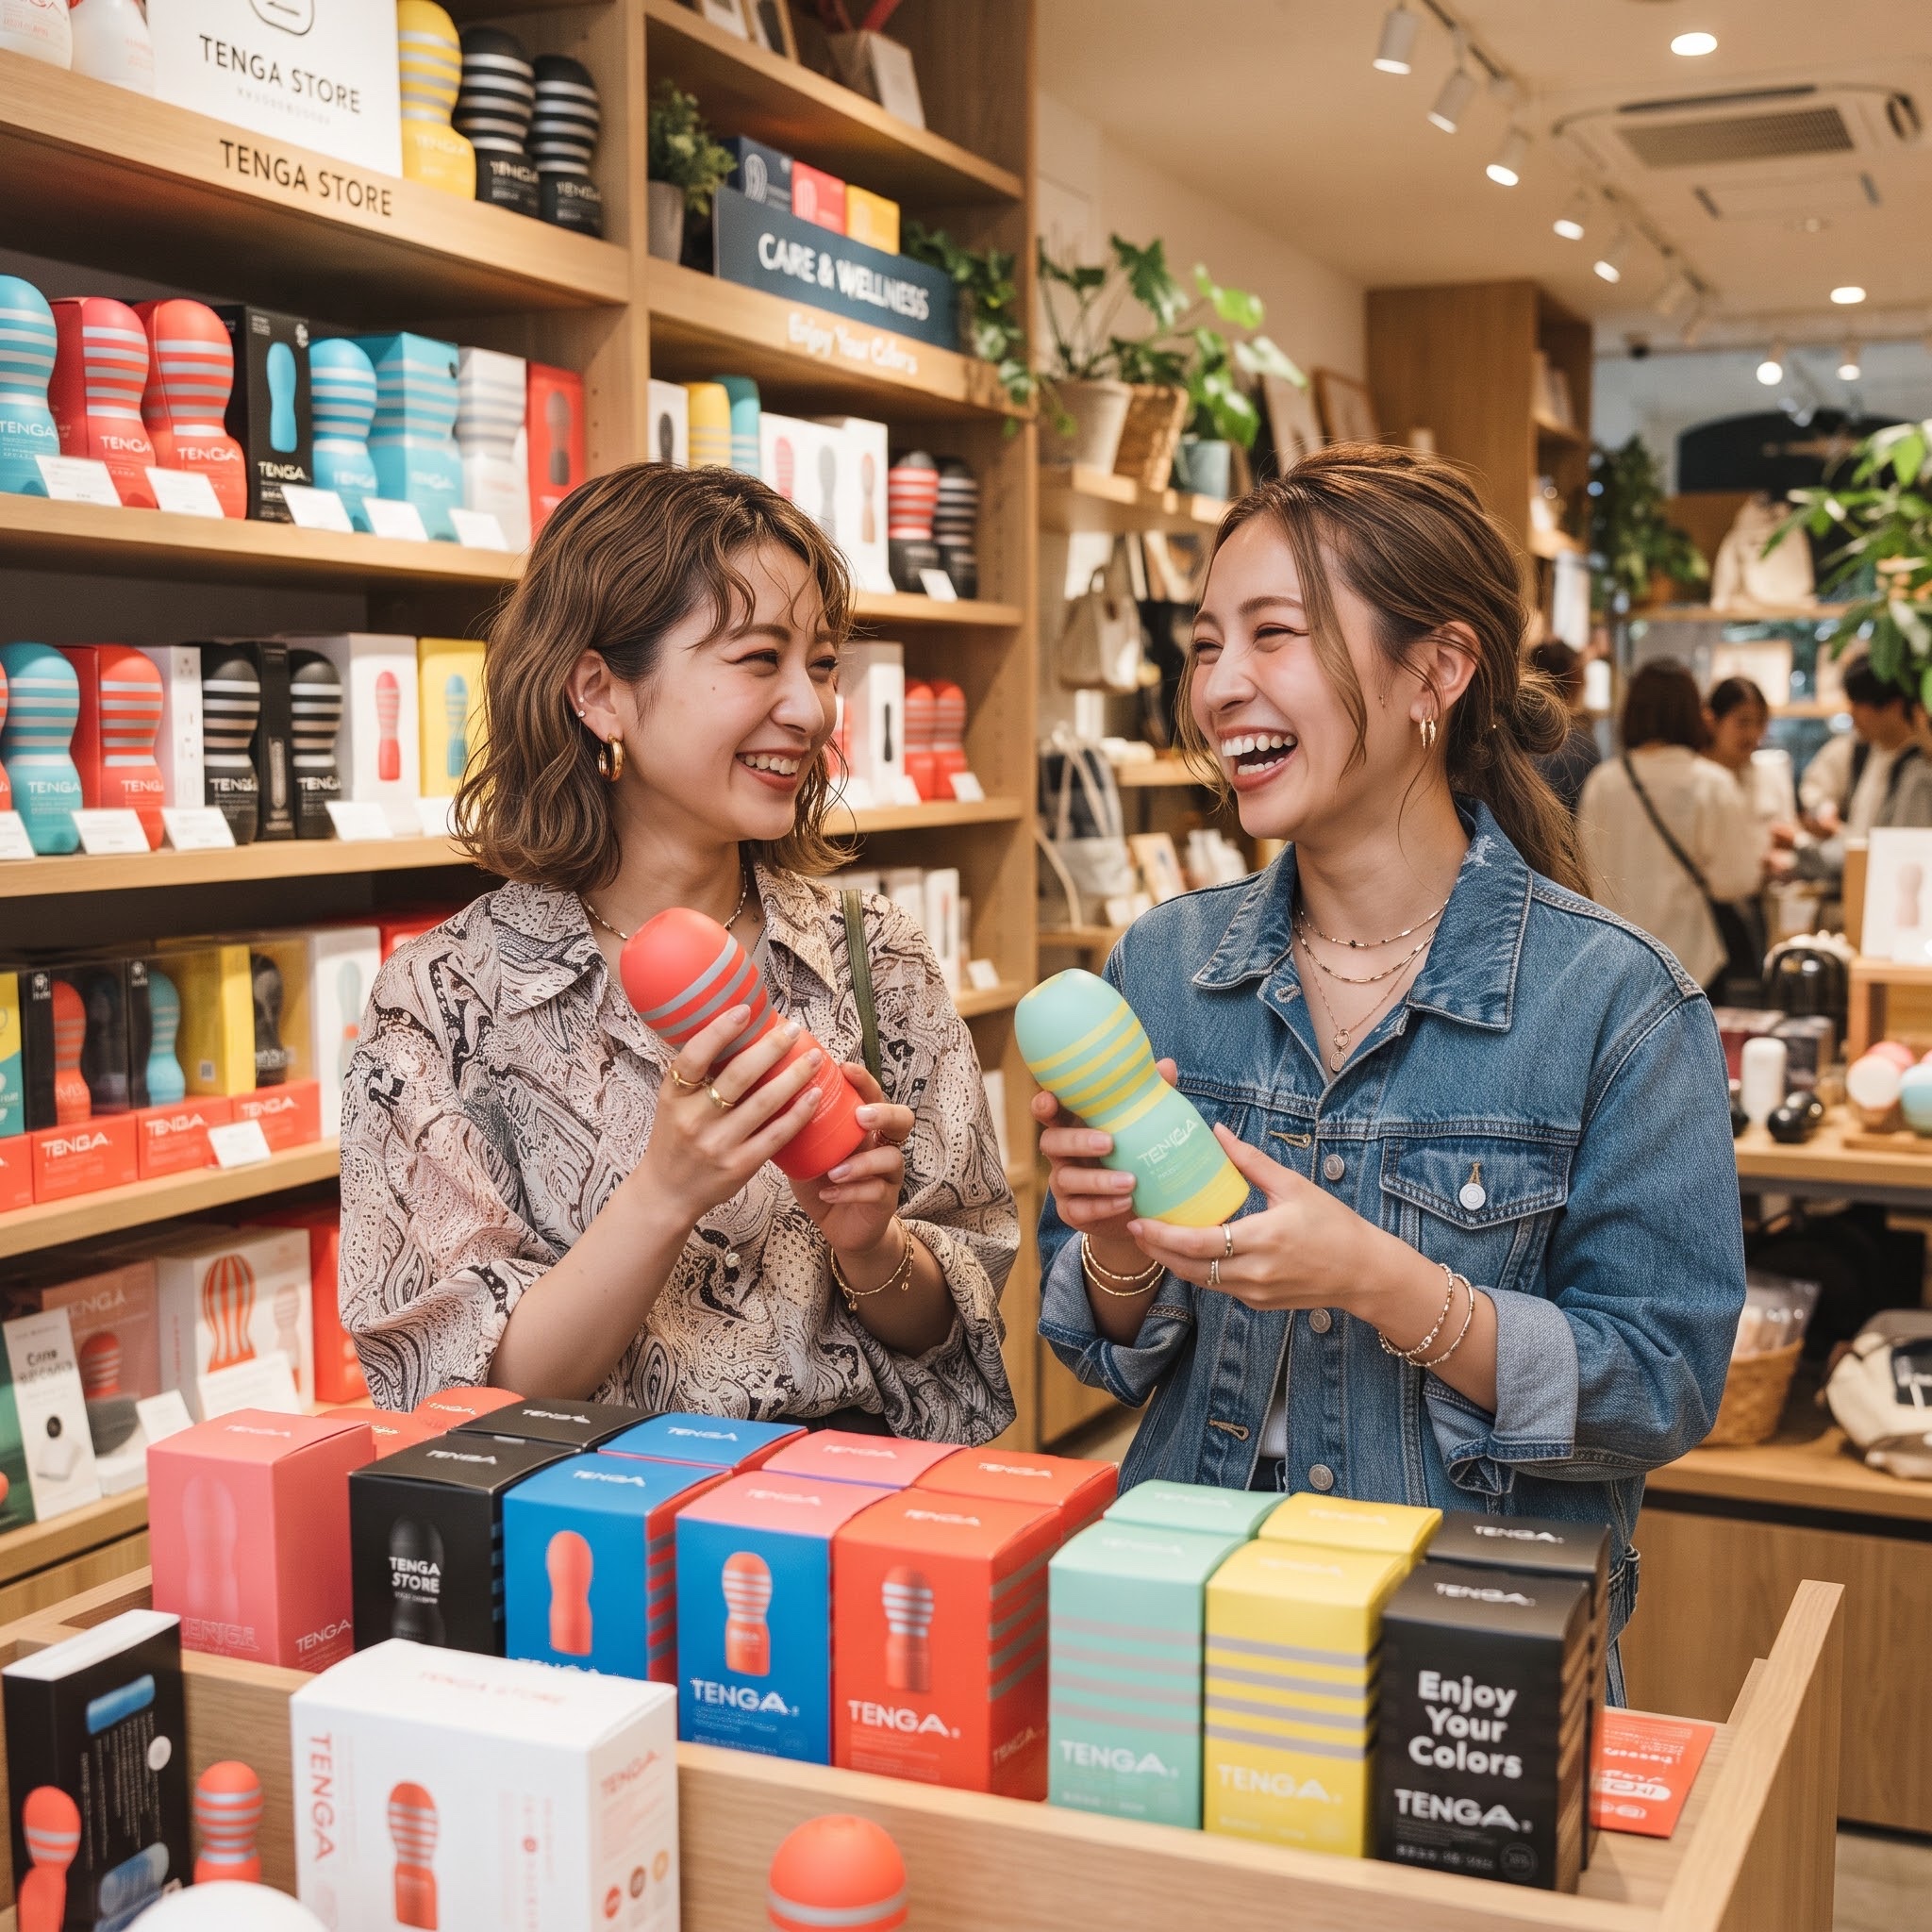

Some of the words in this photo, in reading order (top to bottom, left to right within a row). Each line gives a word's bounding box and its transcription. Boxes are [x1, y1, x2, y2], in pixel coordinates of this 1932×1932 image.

[199, 34, 283, 88] TENGA
[291, 68, 361, 114] STORE
[219, 138, 309, 192] TENGA
[318, 170, 392, 217] STORE
[758, 232, 817, 284] CARE
[817, 251, 835, 291] &
[835, 258, 929, 322] WELLNESS
[177, 446, 240, 461] TENGA
[258, 460, 307, 481] TENGA
[27, 780, 81, 794] TENGA
[144, 1113, 206, 1137] TENGA
[240, 1095, 296, 1119] TENGA
[41, 1131, 109, 1159] TENGA
[389, 1556, 441, 1576] TENGA
[391, 1572, 441, 1594] STORE
[295, 1618, 352, 1654] TENGA
[690, 1677, 791, 1716] TENGA
[1418, 1669, 1518, 1718] Enjoy
[847, 1698, 950, 1738] TENGA
[1424, 1704, 1509, 1744] Your
[1059, 1739, 1169, 1777] TENGA
[1407, 1735, 1523, 1779] Colors
[308, 1730, 337, 1863] TENGA
[1217, 1763, 1331, 1805] TENGA
[1393, 1788, 1521, 1833] TENGA
